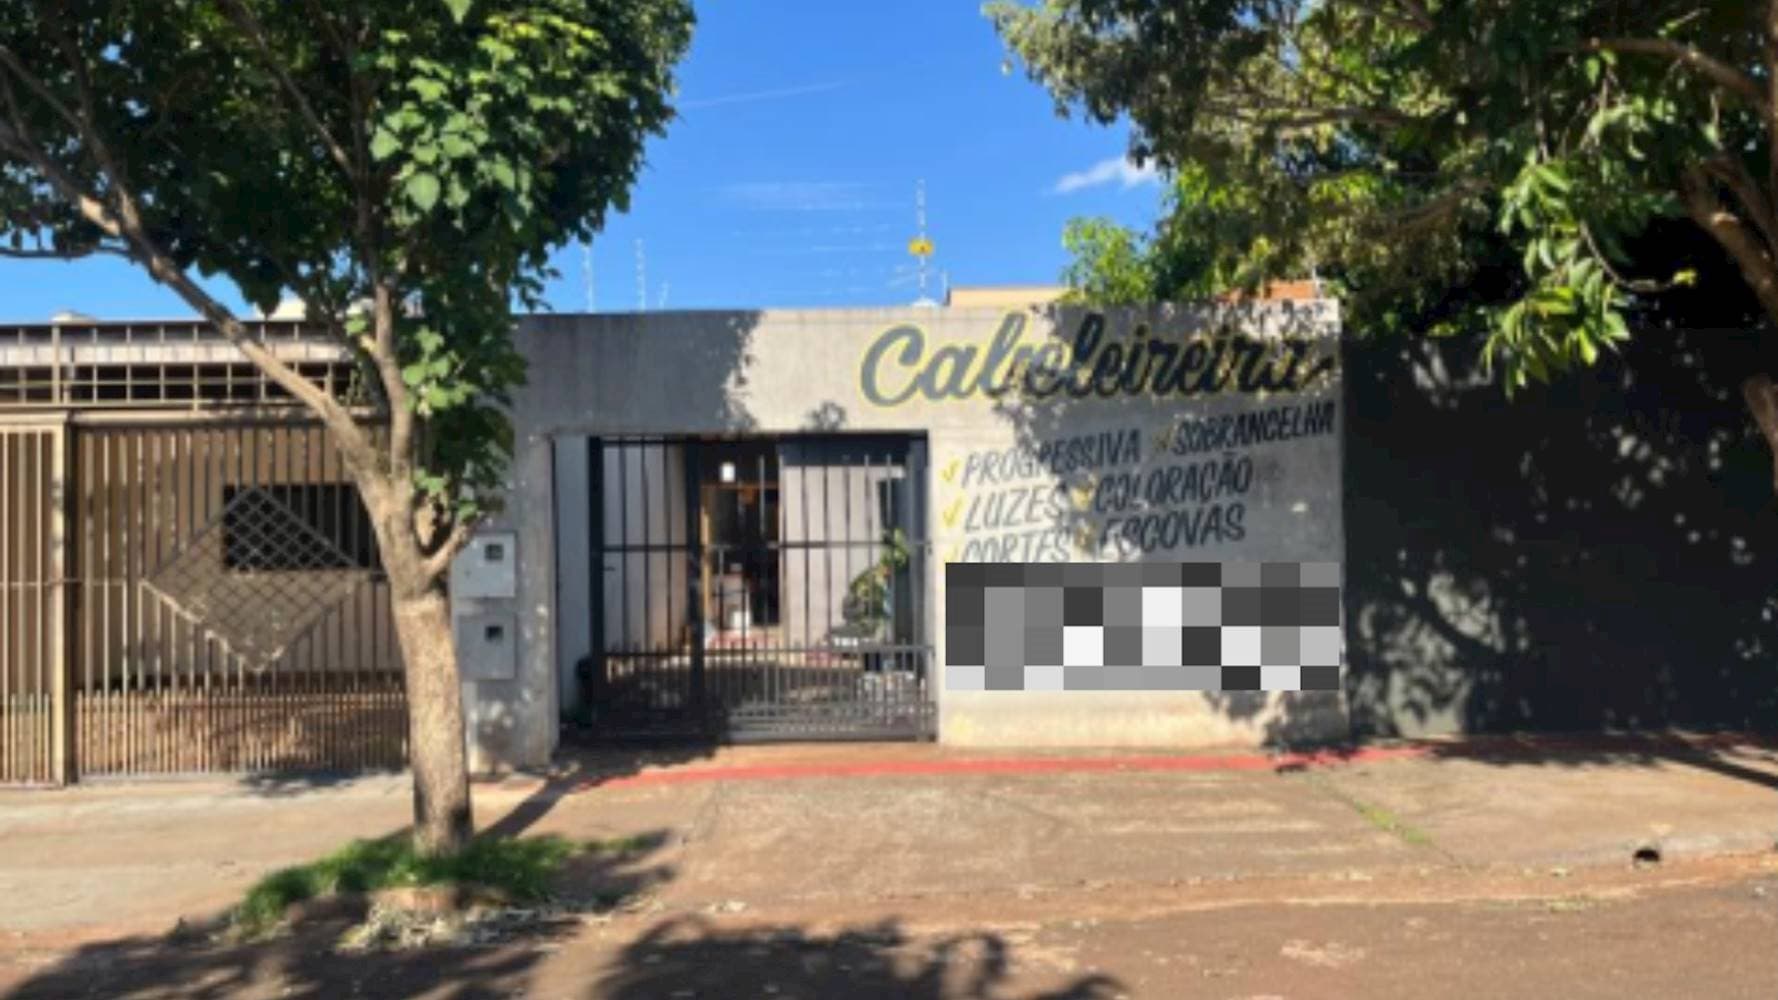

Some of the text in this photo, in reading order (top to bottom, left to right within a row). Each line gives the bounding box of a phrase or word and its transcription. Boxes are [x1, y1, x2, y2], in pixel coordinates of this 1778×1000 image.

[859, 310, 1335, 407] Cabeleireira
[962, 401, 1335, 488] PROGRESSIVA SOBRANCELHA
[964, 452, 1253, 531] LUZES COLORAÇÃO
[1101, 503, 1246, 552] ESCOVAS
